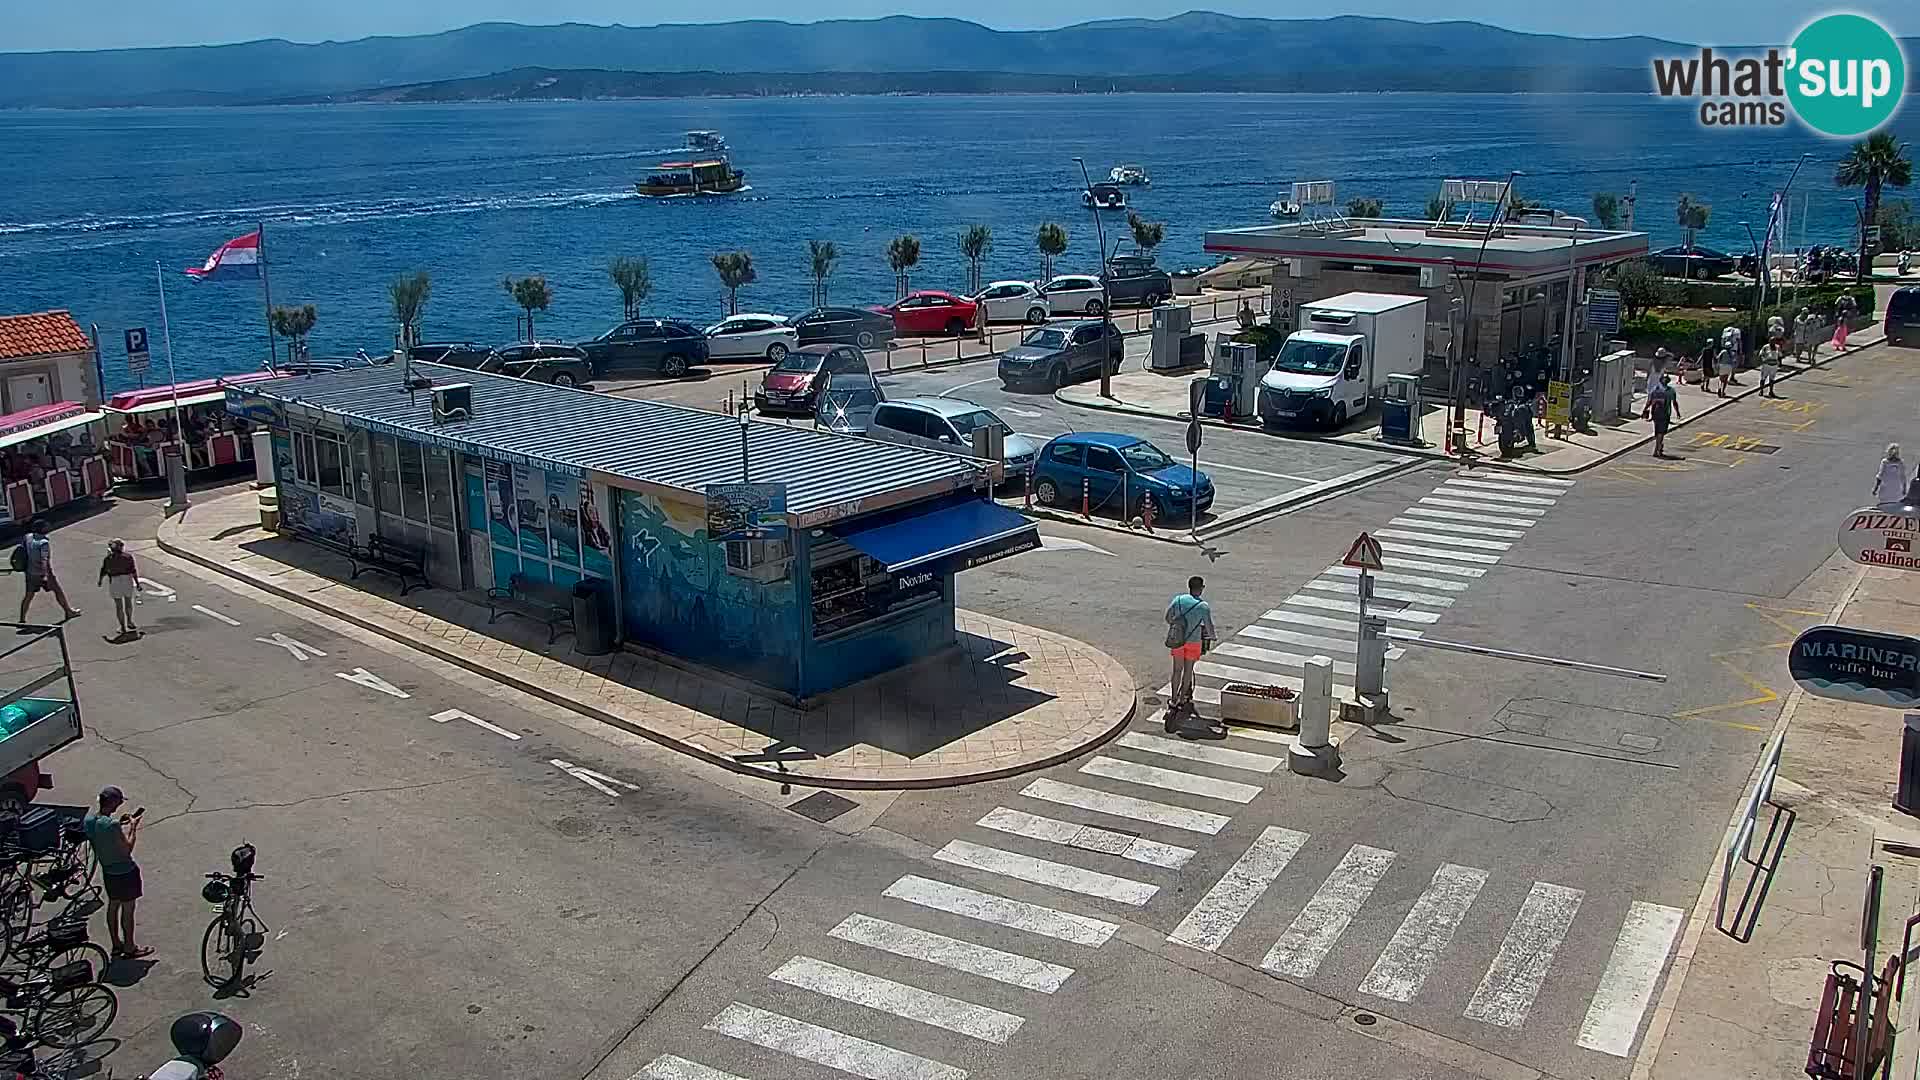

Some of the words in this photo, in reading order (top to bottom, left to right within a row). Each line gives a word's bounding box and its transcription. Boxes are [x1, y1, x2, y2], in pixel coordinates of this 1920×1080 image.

[130, 331, 142, 349] P
[1687, 432, 1764, 451] TAXI
[477, 447, 493, 458] BUS
[494, 450, 526, 465] STATION
[528, 457, 554, 471] TICKET
[555, 463, 583, 477] OFFICE
[1849, 515, 1920, 531] PIZZE
[1882, 530, 1918, 540] GRILL
[1871, 664, 1897, 680] bar
